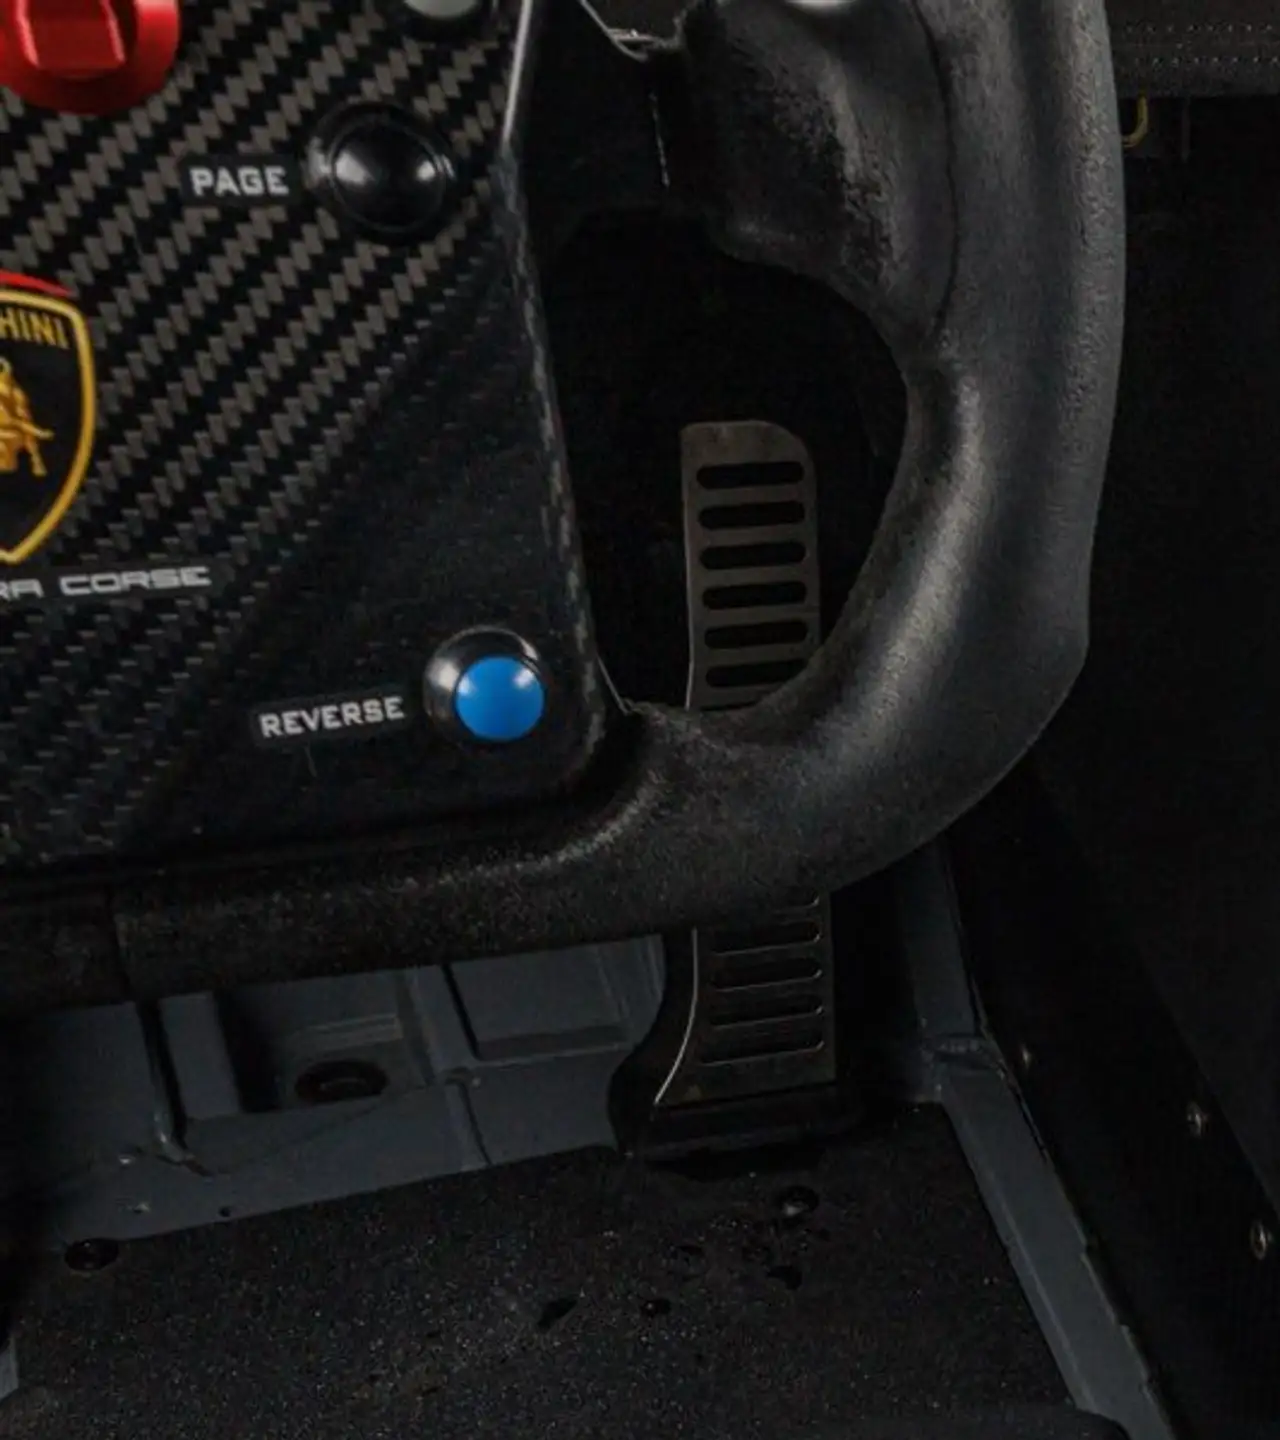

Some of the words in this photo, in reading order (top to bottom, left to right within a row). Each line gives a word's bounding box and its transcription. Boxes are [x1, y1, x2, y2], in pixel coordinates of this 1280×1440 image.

[188, 165, 290, 196] PAGE
[60, 566, 211, 596] CORSE
[259, 696, 405, 738] REVERSE
